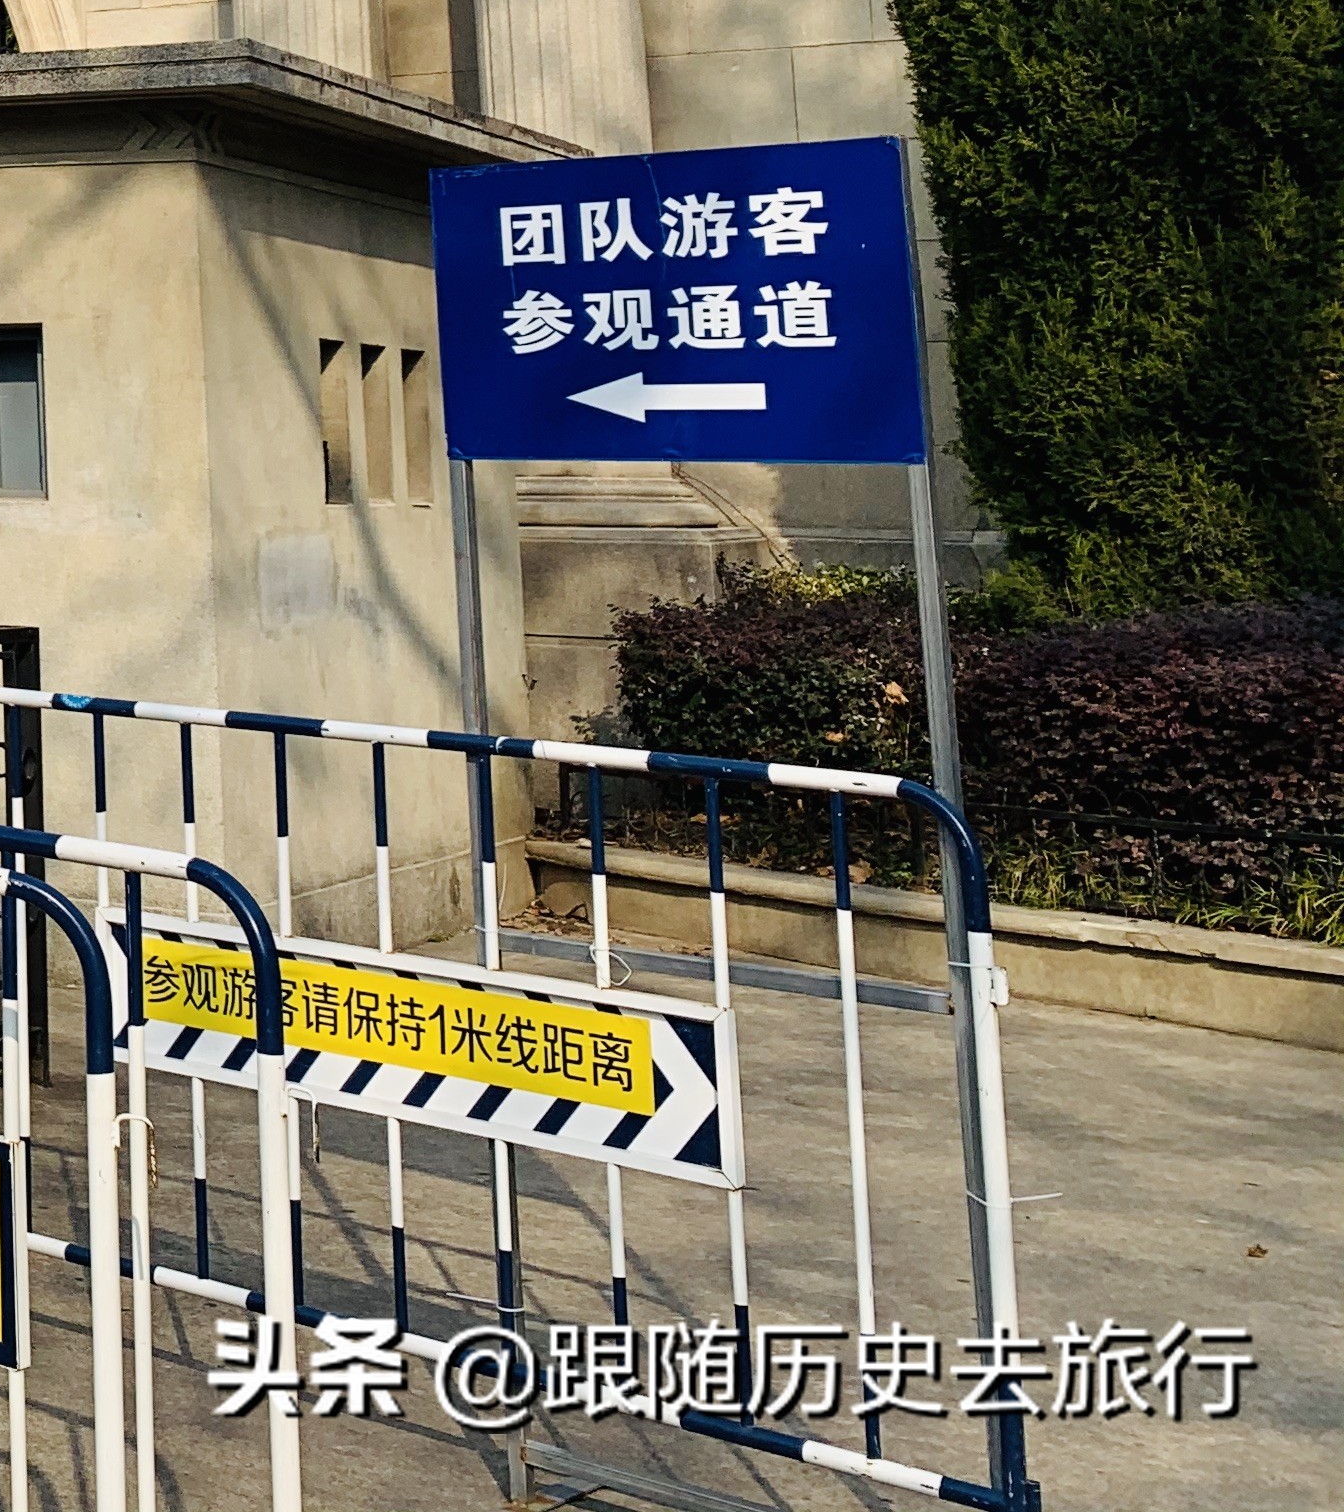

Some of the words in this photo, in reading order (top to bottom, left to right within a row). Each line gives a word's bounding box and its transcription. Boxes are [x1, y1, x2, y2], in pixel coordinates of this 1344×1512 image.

[500, 186, 829, 267] 团队游客
[503, 280, 837, 355] 参观通道
[143, 955, 633, 1093] 参观游客请保持1米线距离
